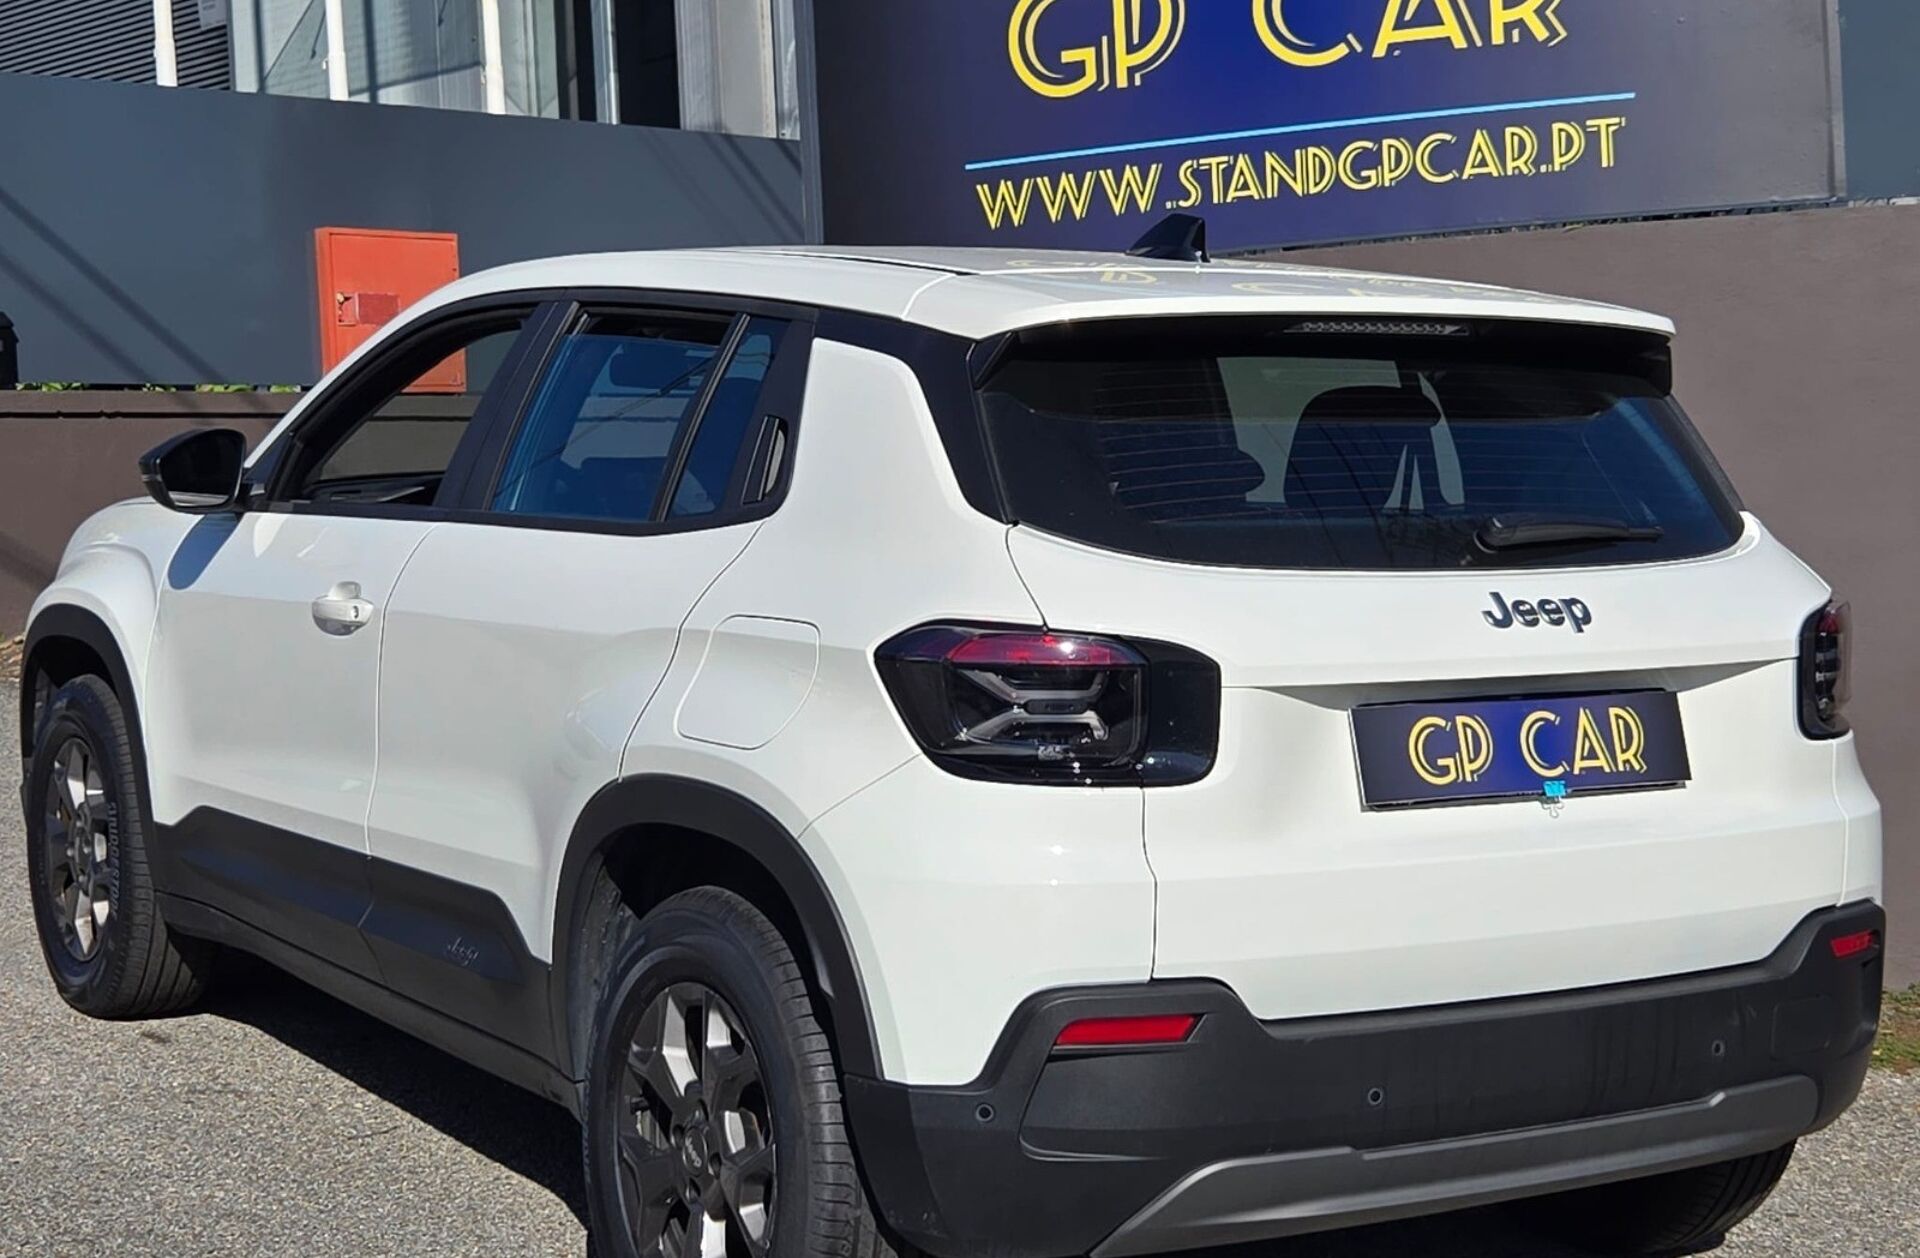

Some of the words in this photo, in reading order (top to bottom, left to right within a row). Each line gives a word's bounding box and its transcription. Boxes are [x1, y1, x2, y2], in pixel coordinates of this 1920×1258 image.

[1008, 0, 1185, 98] GP
[976, 116, 1626, 230] WWW.STANDGPCAR.PT
[1481, 591, 1593, 634] Jeep
[1408, 715, 1494, 785] GP
[1519, 706, 1648, 778] CAR
